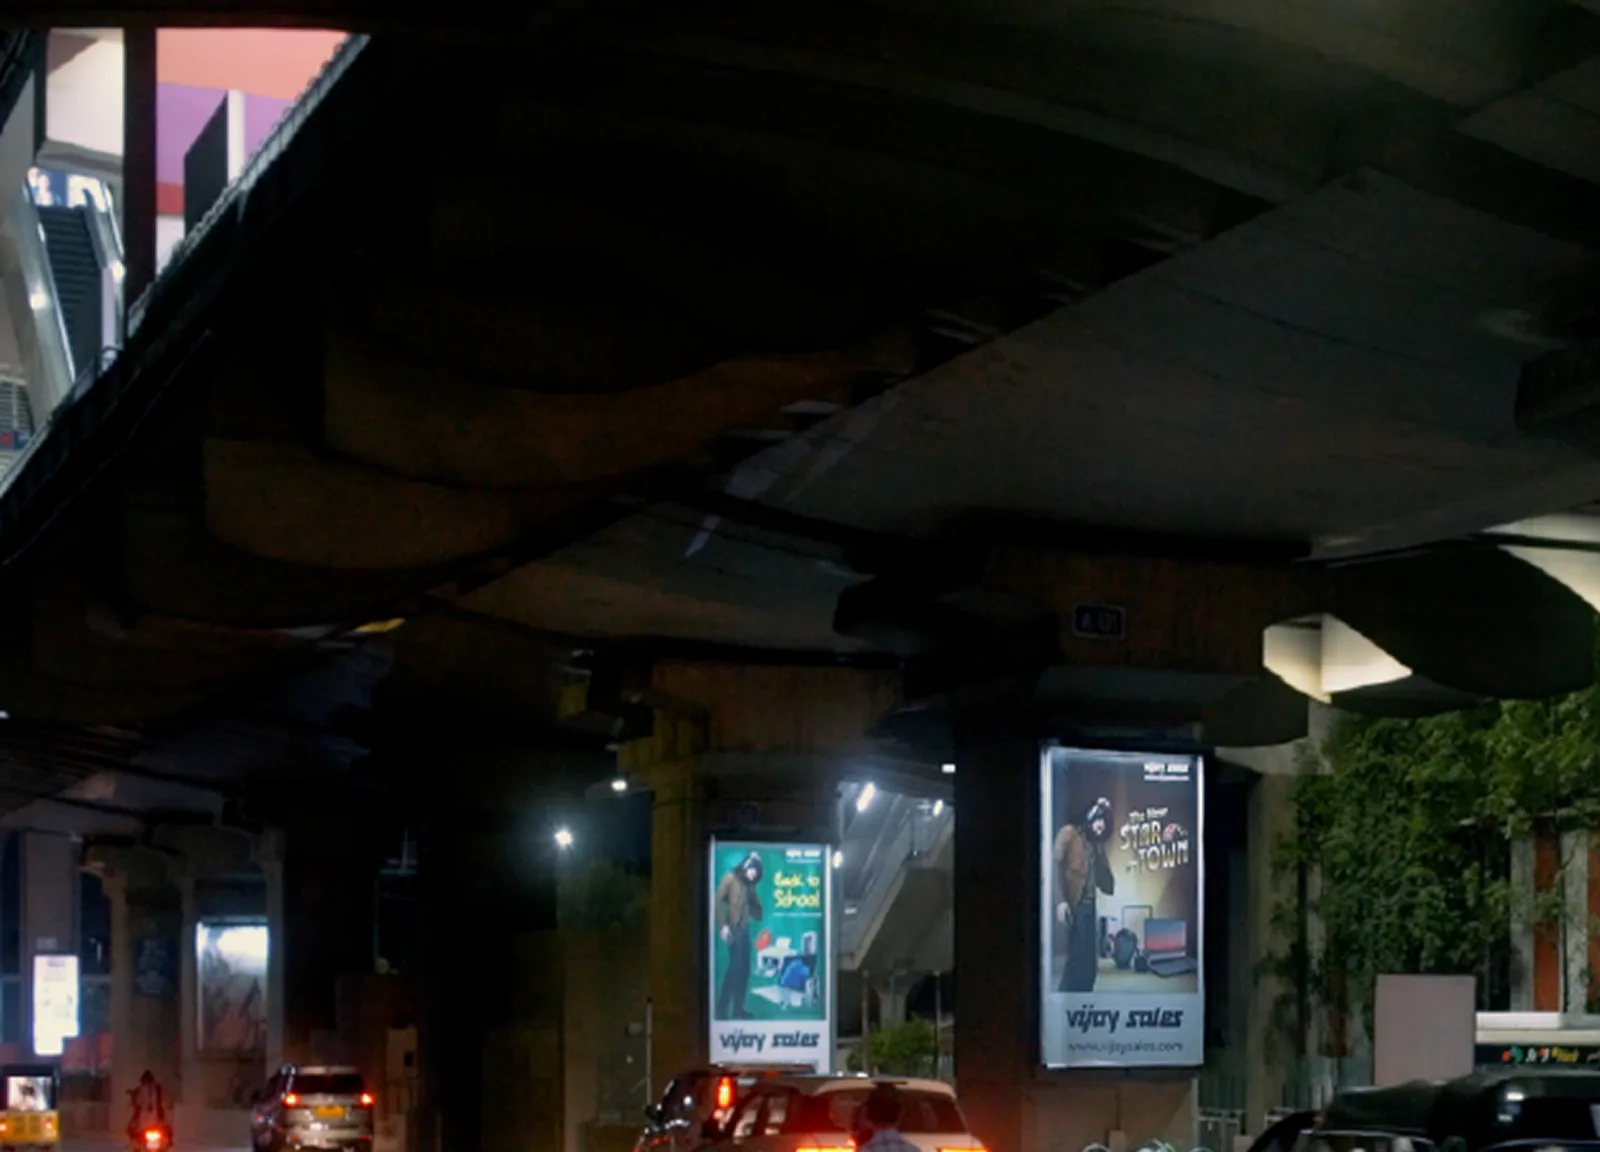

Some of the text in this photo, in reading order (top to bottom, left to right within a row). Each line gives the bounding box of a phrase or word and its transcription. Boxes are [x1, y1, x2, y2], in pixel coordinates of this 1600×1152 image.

[1120, 821, 1161, 850] STAR
[1138, 840, 1189, 871] TOWN
[1066, 1004, 1184, 1034] vijay sales
[720, 1028, 820, 1054] vijay sales
